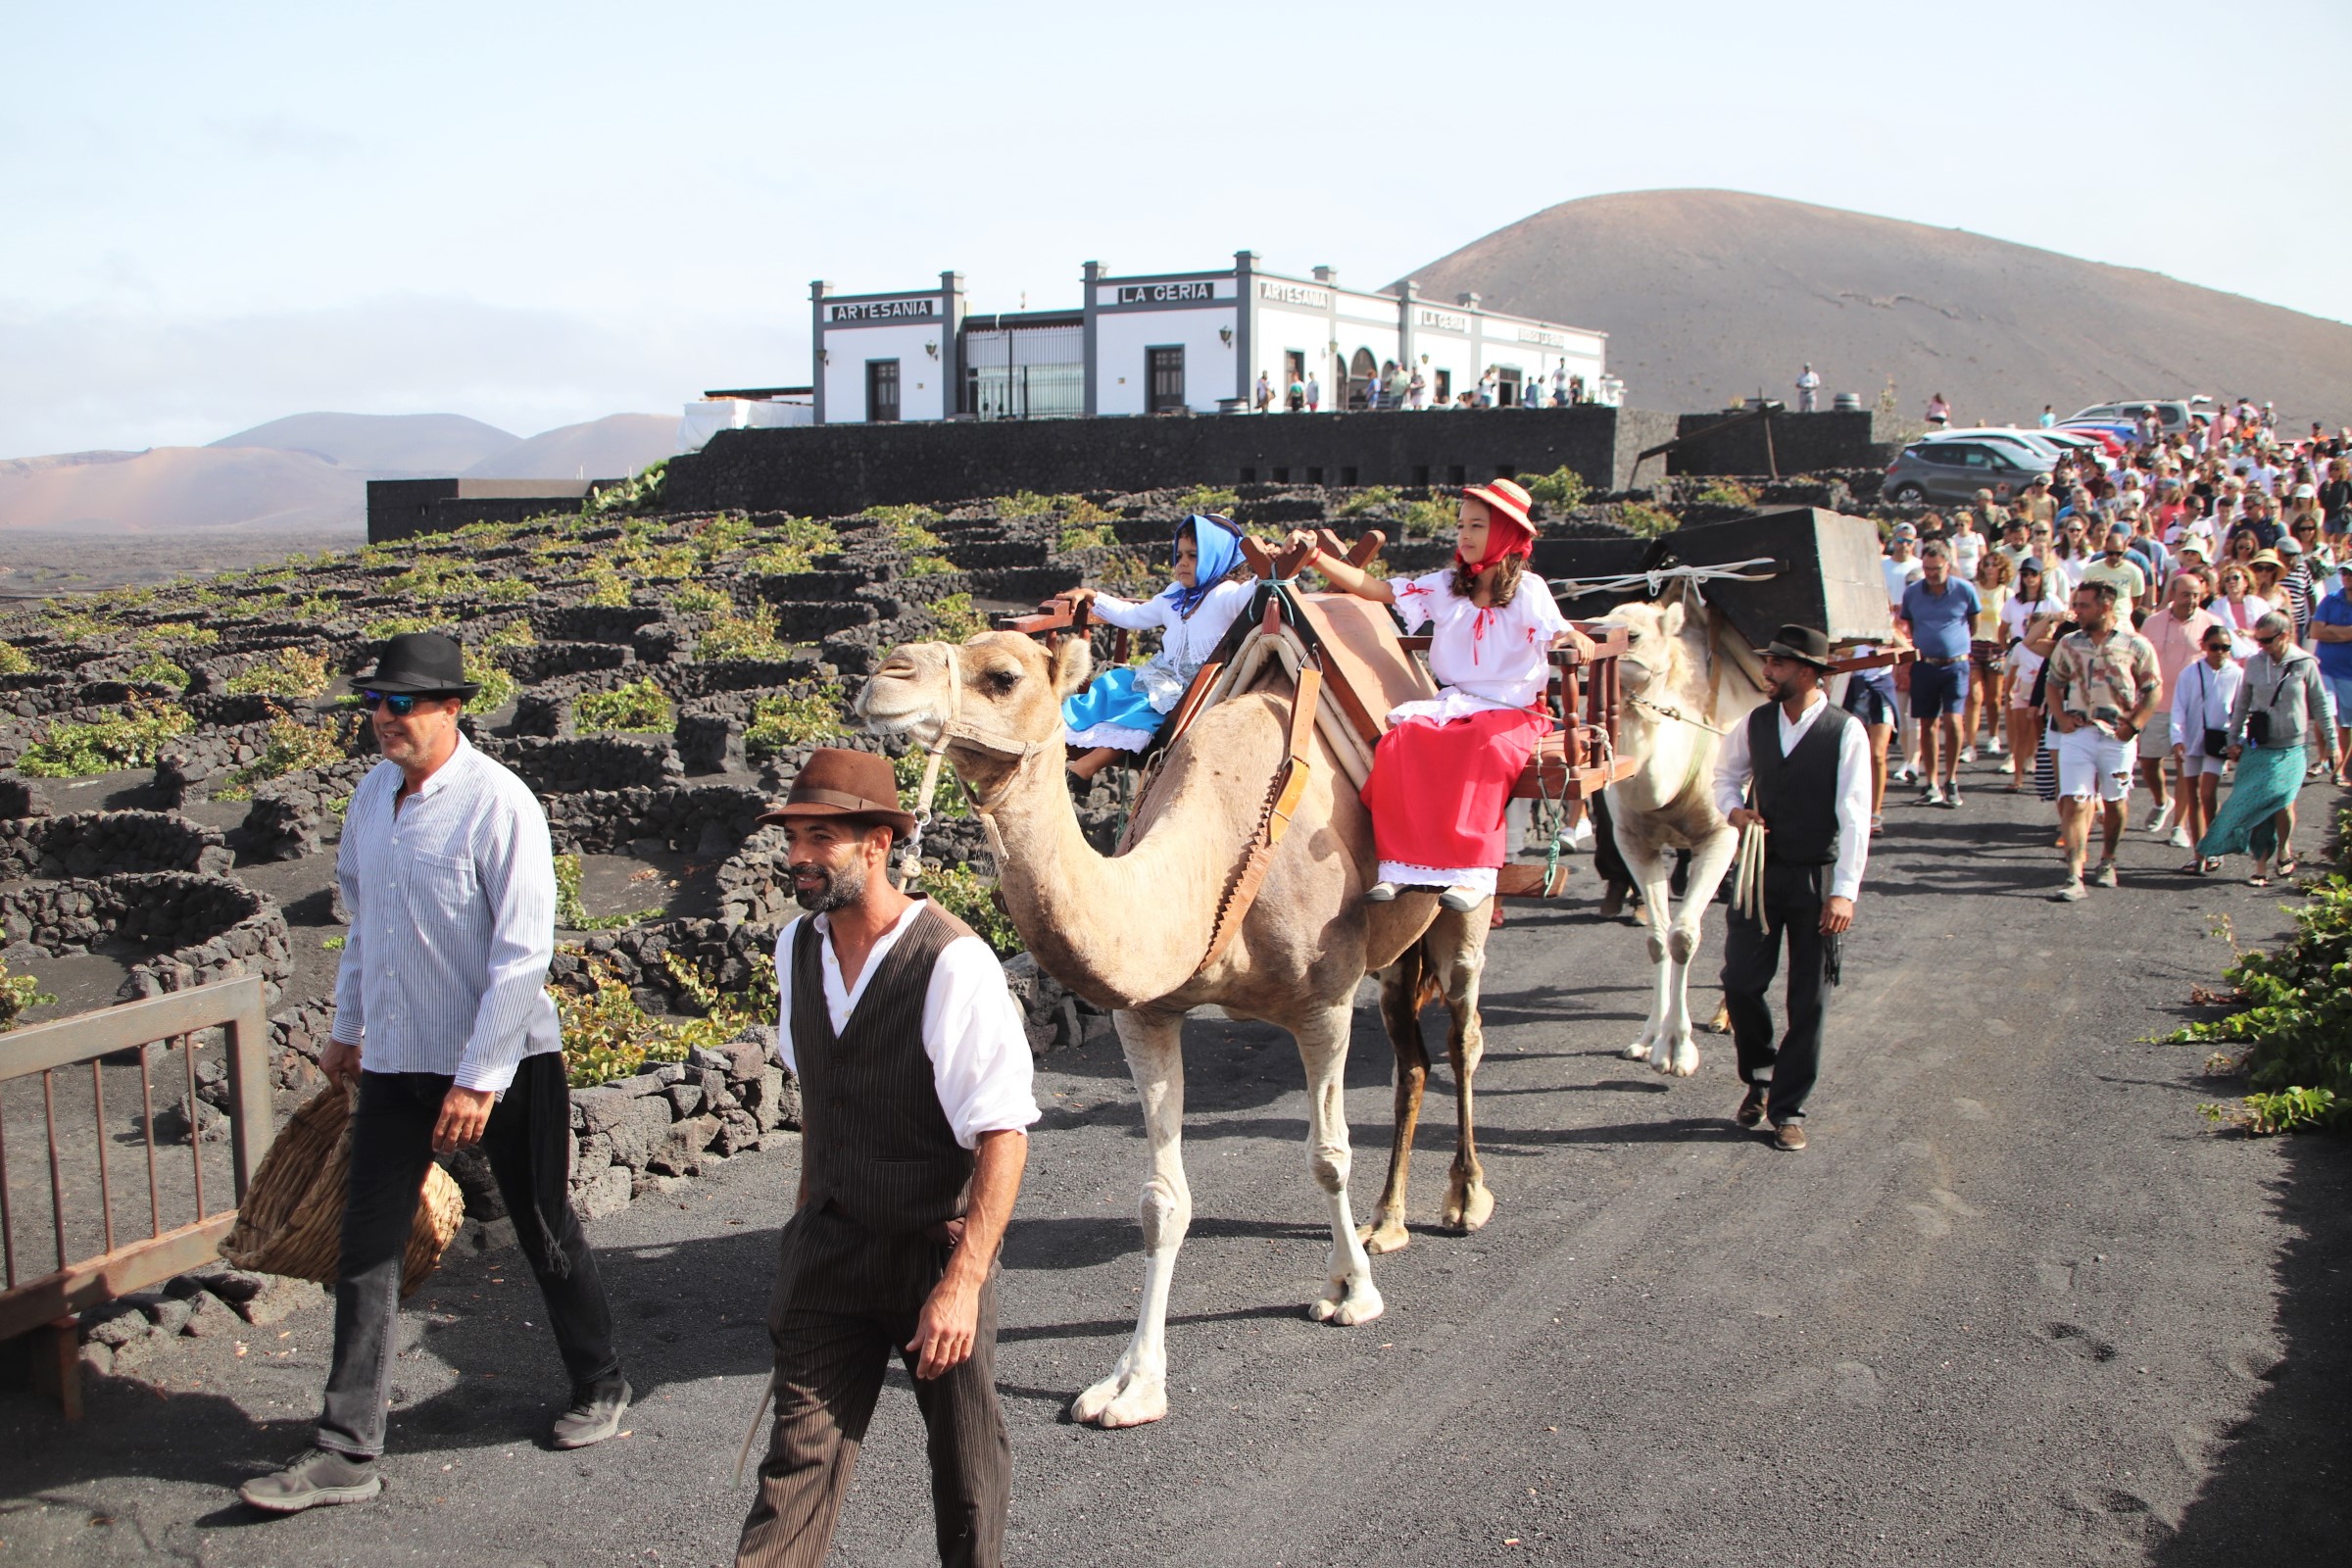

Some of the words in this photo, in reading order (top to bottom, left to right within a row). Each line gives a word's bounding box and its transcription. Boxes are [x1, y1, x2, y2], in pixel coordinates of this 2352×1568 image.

[1122, 288, 1146, 303] LA
[1153, 283, 1208, 301] GERIA
[1263, 283, 1327, 309] ARTESANIA
[838, 301, 928, 319] ARTESANIA
[1424, 311, 1436, 326] LA
